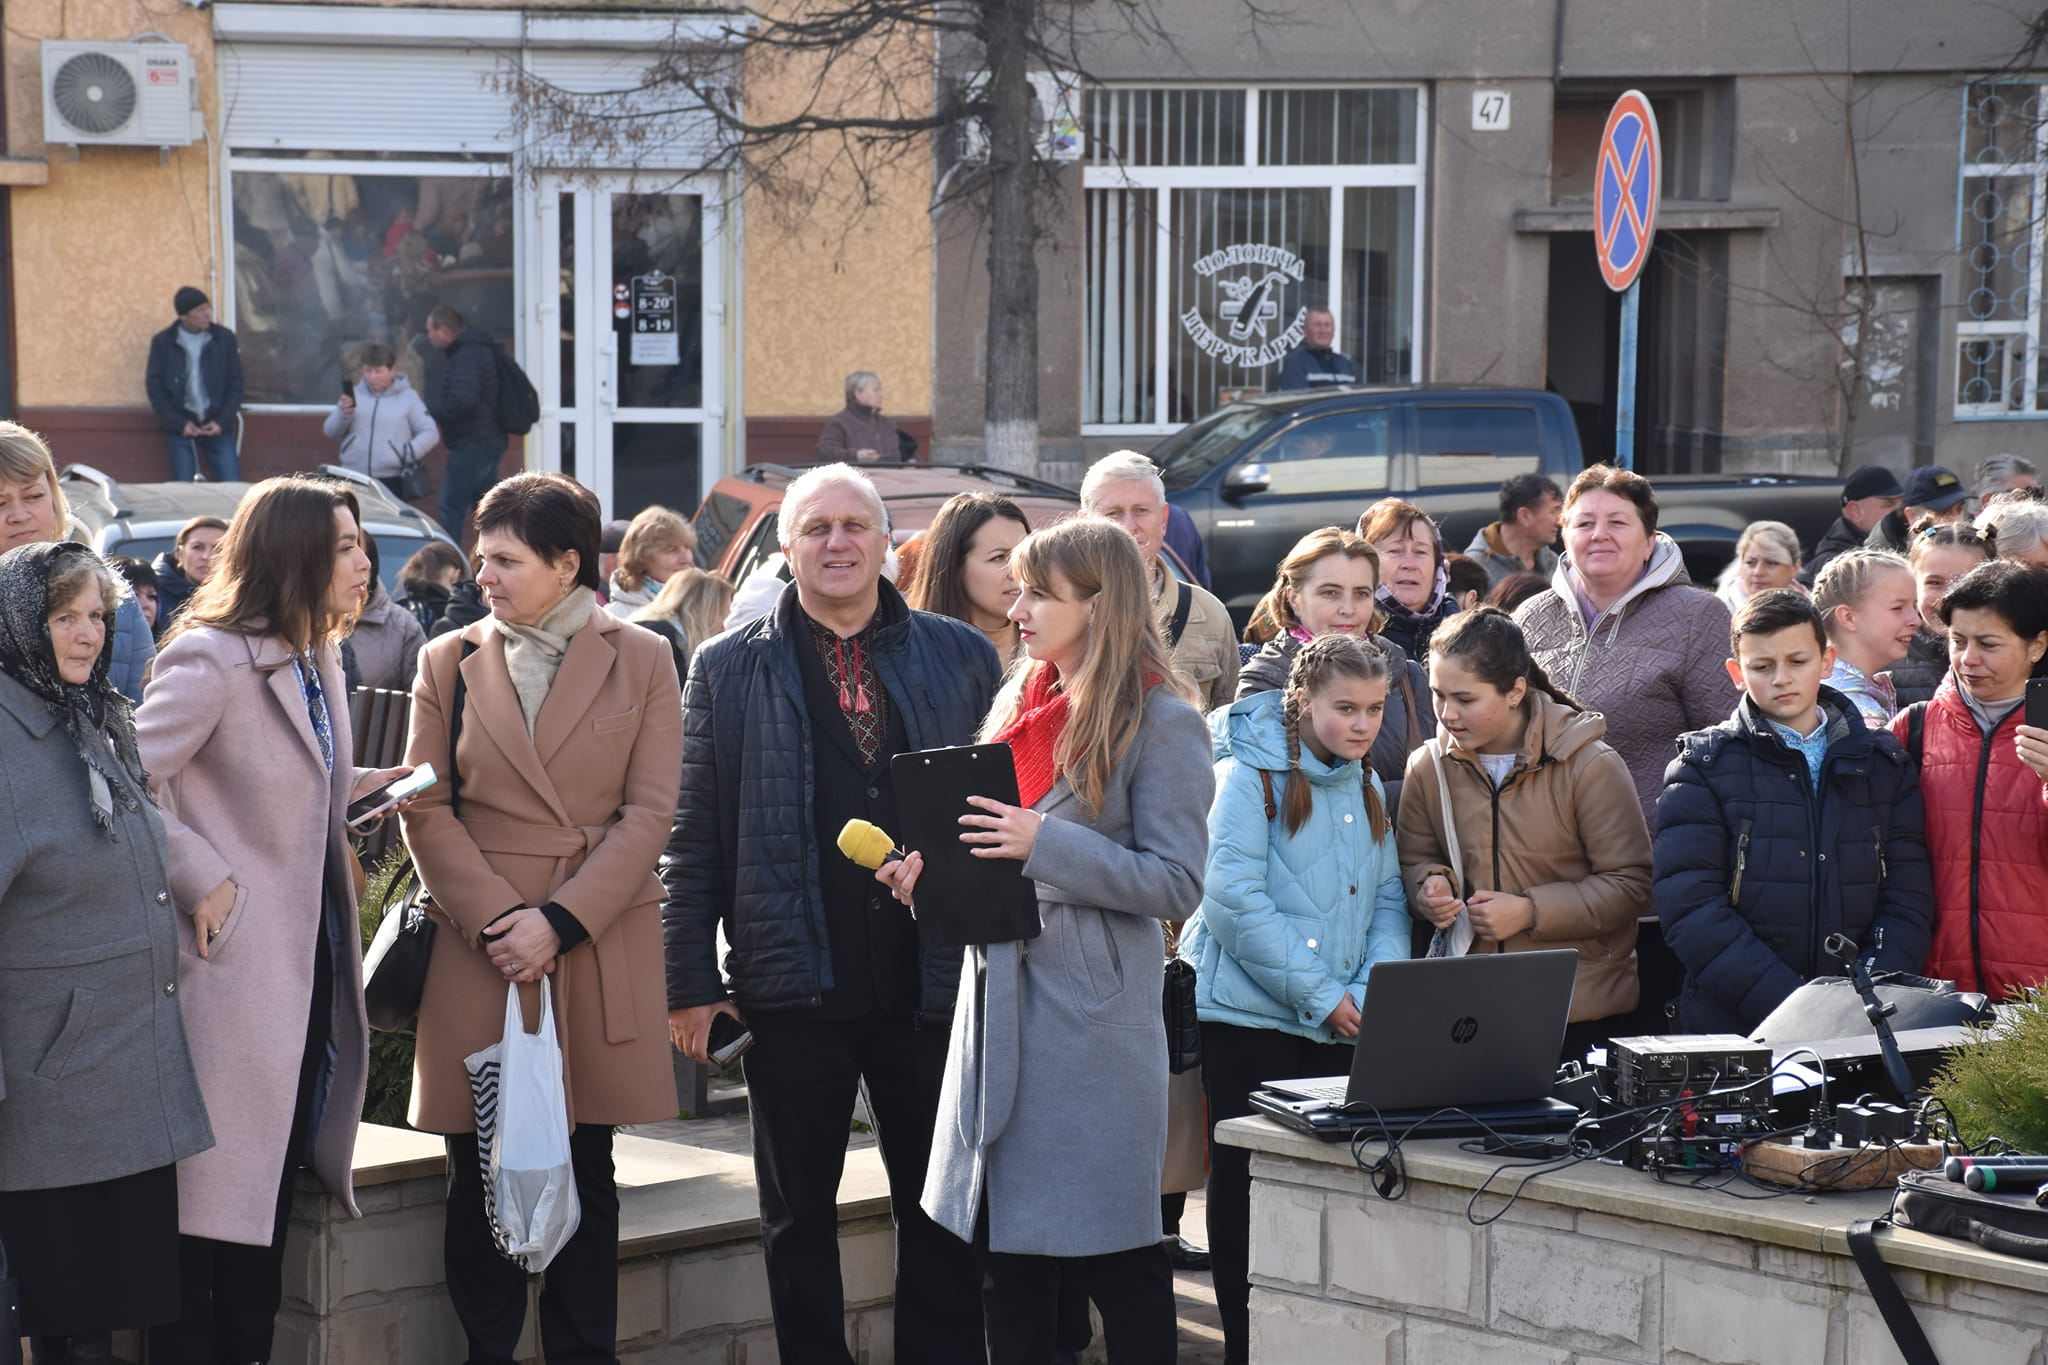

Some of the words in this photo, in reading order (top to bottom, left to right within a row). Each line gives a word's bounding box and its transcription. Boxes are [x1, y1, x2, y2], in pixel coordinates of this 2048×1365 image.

[1480, 96, 1504, 123] 47
[1193, 243, 1305, 282] ЧОЛОВІЧА
[1451, 1016, 1478, 1044] hp
